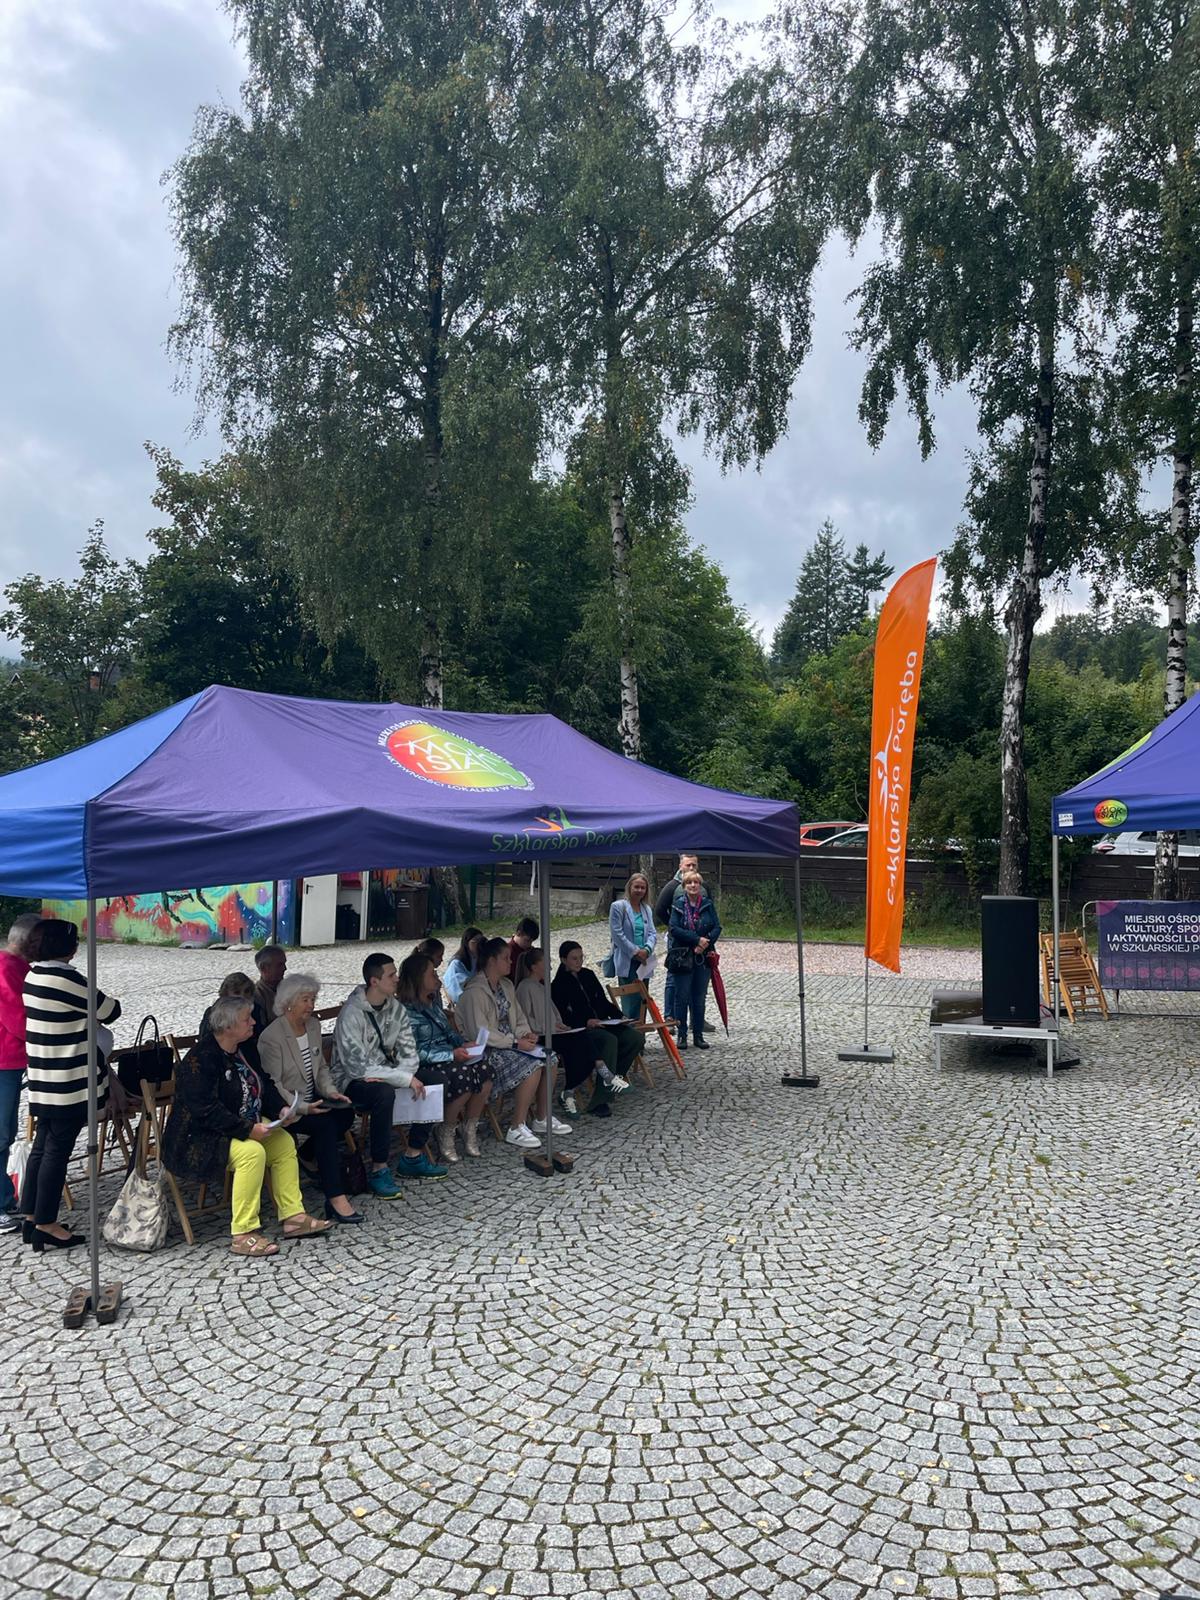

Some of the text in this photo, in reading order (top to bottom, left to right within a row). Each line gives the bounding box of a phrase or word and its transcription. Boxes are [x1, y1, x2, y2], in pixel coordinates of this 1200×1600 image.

[490, 832, 578, 855] Szklarska
[1125, 913, 1200, 923] MIEJSKI OŚRO
[1125, 925, 1200, 934] KULTURY, SPO
[1112, 933, 1181, 942] AKTYWNOŚCI
[1185, 934, 1200, 942] LO
[1122, 944, 1189, 952] SZKLARSKIEJ
